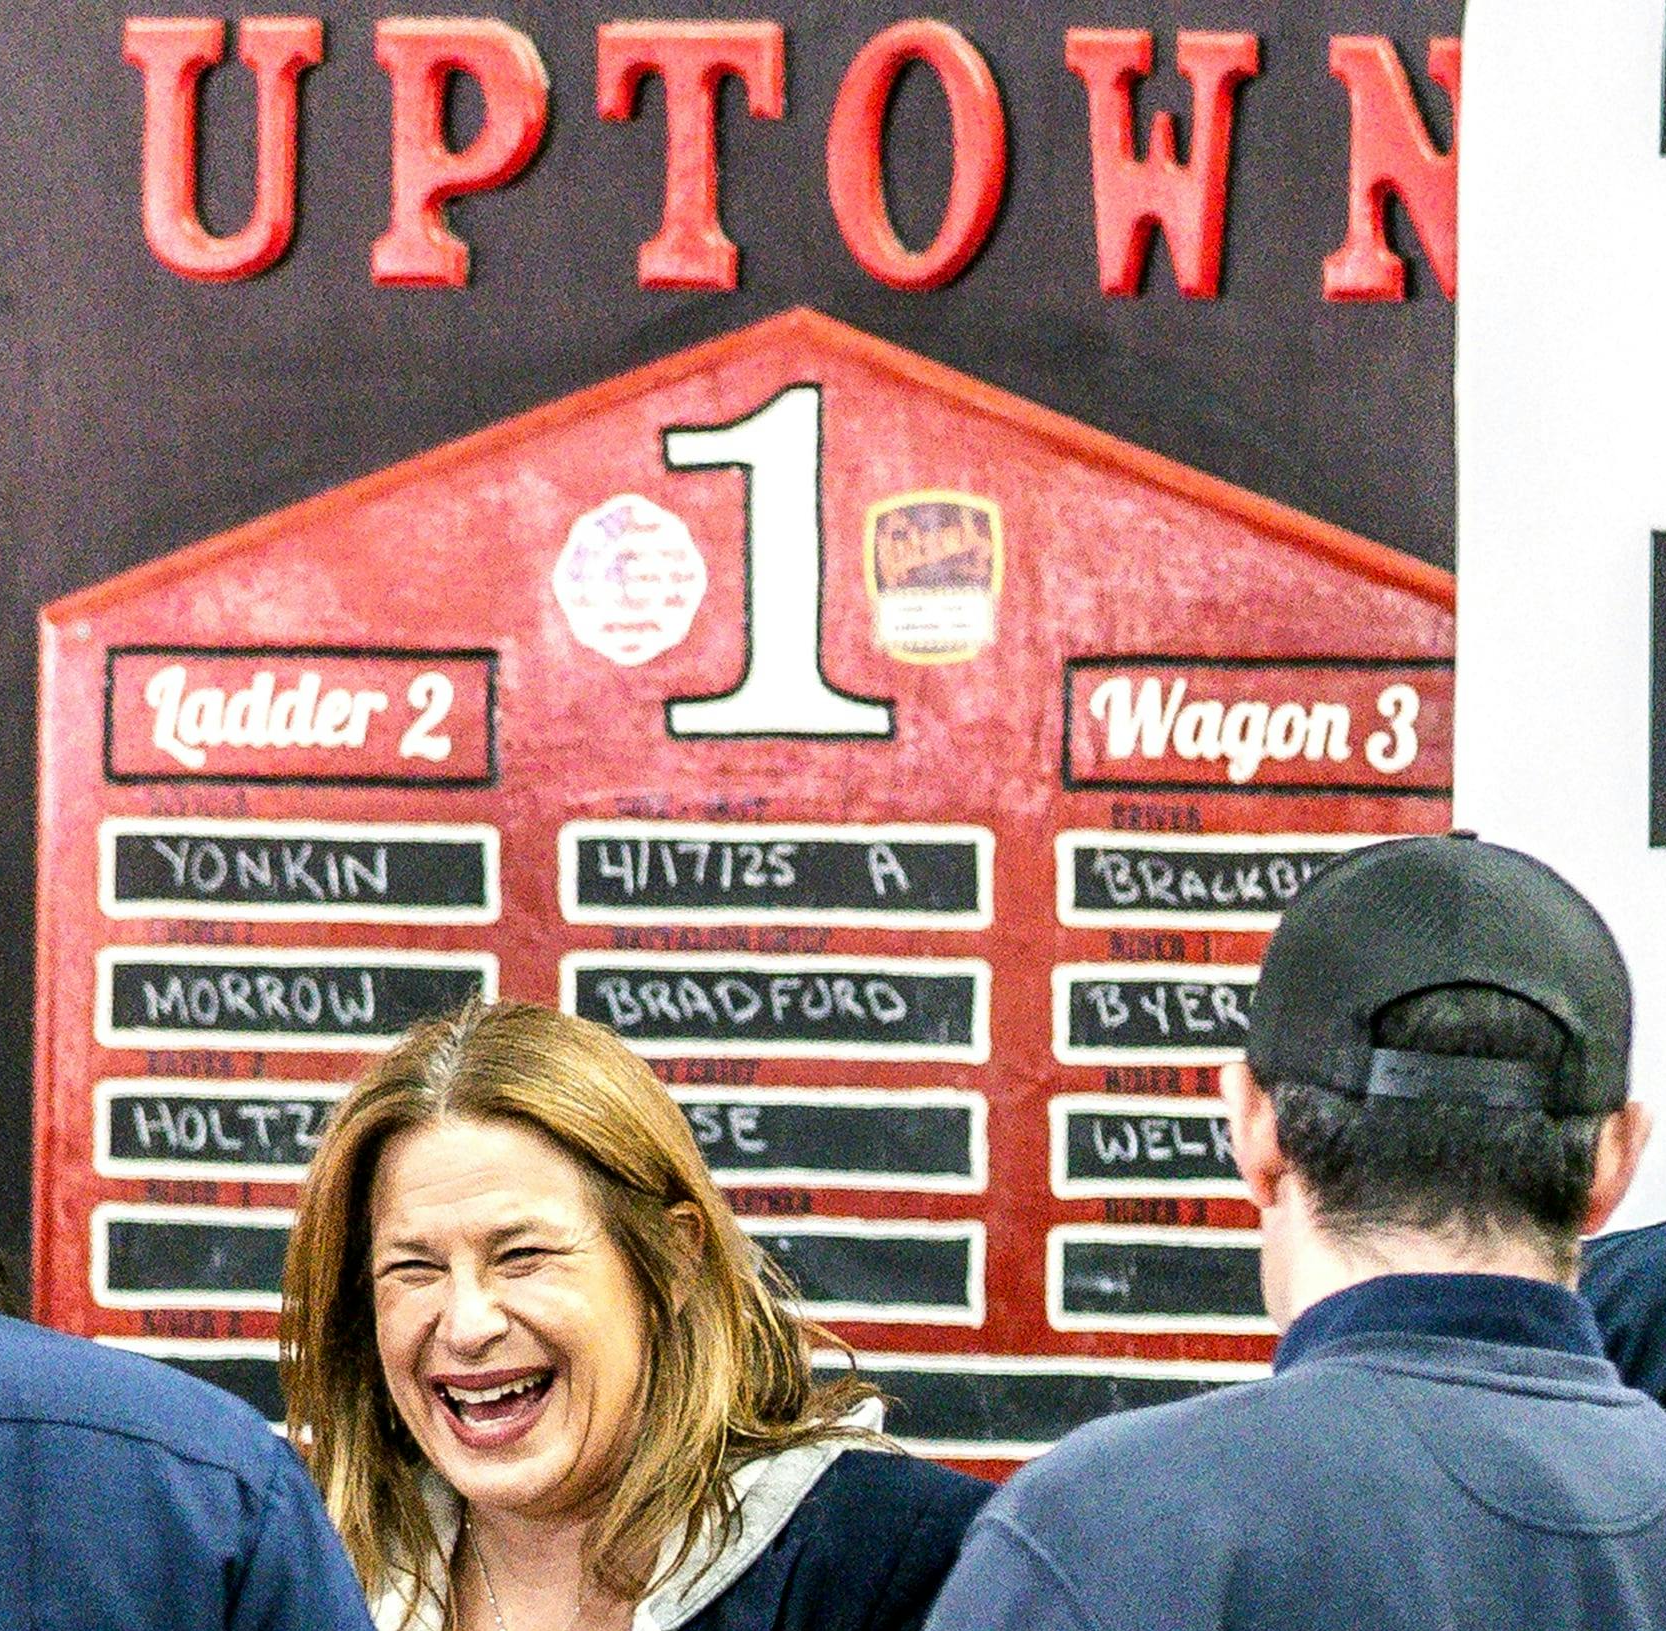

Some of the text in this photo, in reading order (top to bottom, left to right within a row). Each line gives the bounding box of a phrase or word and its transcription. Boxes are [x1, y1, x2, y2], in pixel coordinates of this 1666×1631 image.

[122, 16, 1461, 303] UPTOWN
[662, 382, 894, 742] 1
[144, 666, 455, 768] Ladder 2
[1089, 676, 1422, 783] Wagon 3
[151, 838, 389, 899] YONKIN
[866, 842, 911, 896] A
[141, 972, 376, 1026] MORROW
[595, 976, 909, 1027] BRADFORD
